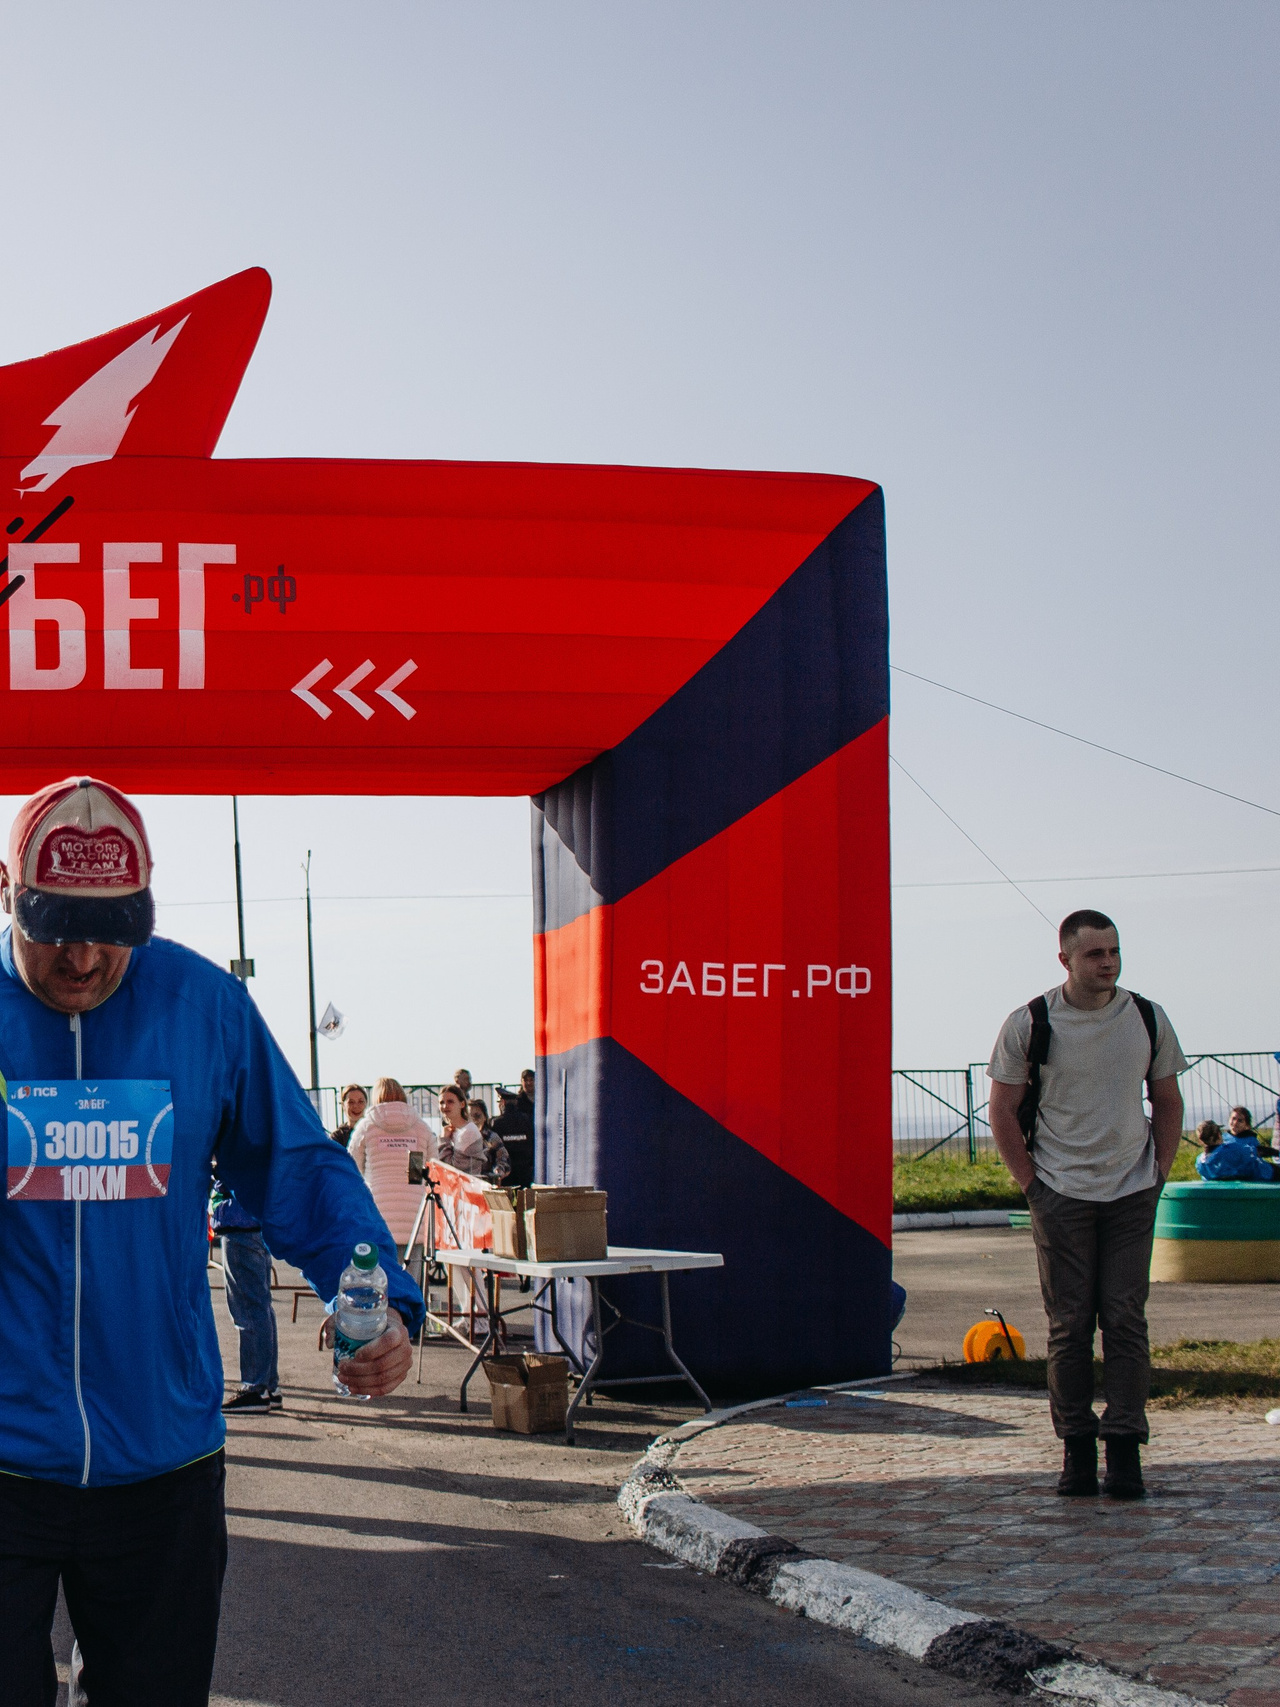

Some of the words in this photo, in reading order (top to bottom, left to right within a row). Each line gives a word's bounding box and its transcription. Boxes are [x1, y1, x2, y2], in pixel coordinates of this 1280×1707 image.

[61, 842, 121, 853] MOTORS
[66, 852, 119, 860] RACING
[70, 861, 115, 869] TEAM
[640, 959, 872, 998] ЗАБЕГ.РФ
[33, 1087, 58, 1097] ПСБ
[44, 1120, 140, 1161] 30015
